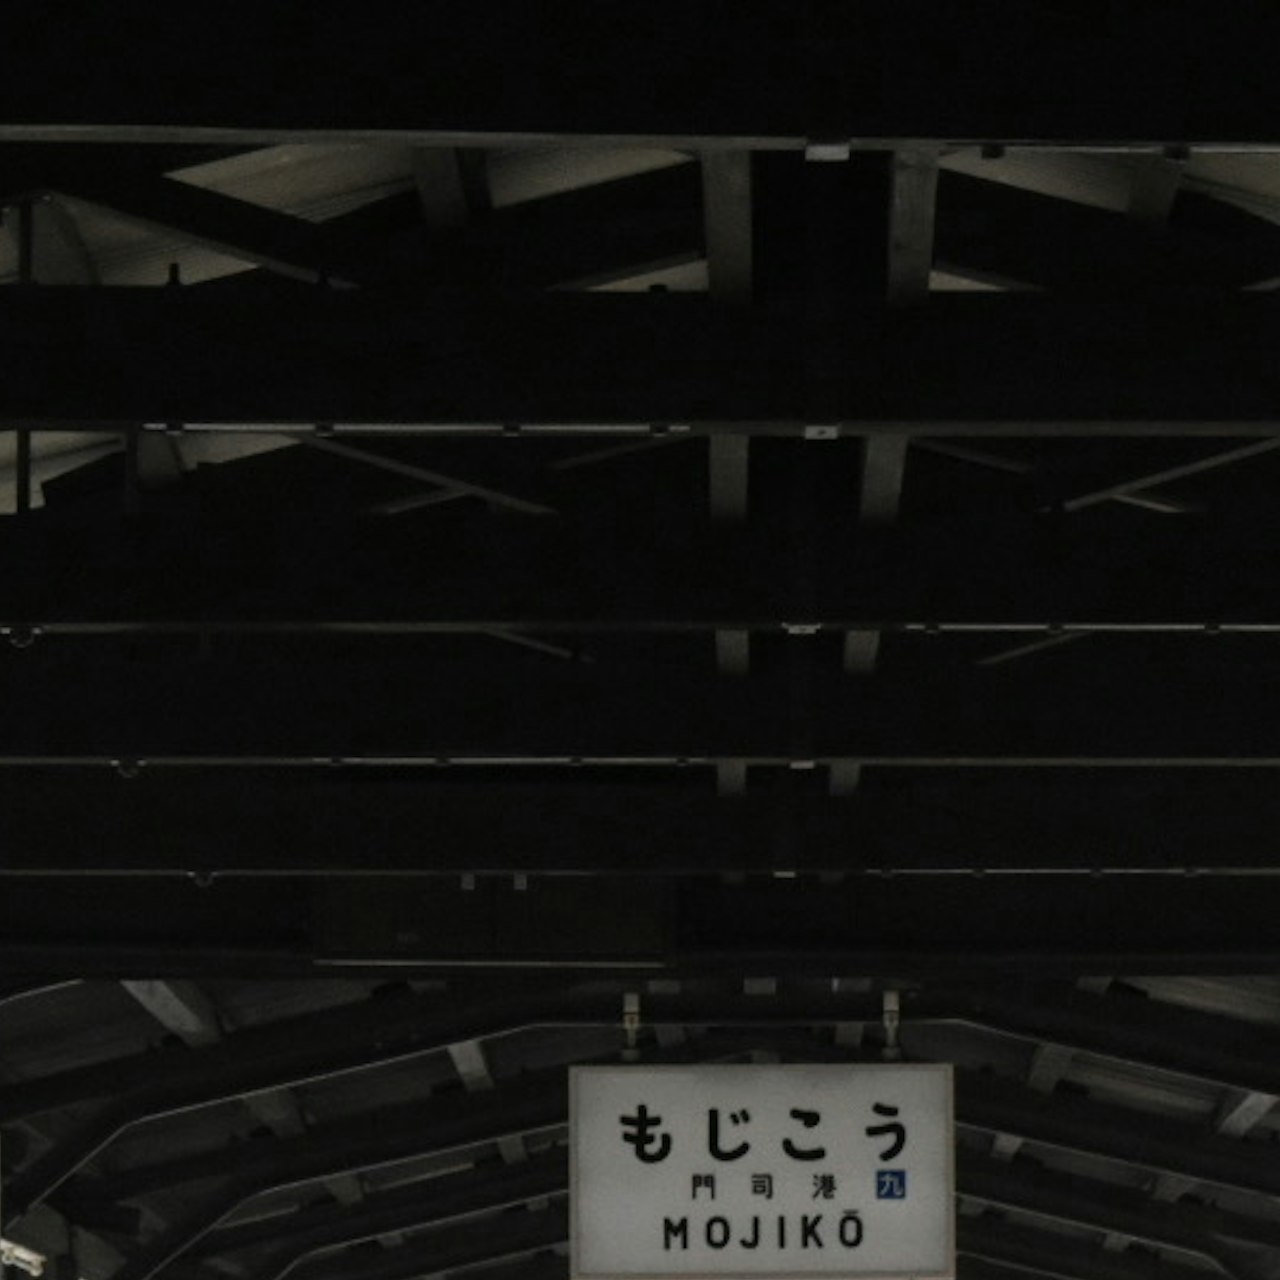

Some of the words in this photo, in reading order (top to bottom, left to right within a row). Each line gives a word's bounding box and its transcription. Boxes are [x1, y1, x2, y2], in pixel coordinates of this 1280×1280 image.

[619, 1102, 907, 1163] もじこう
[692, 1173, 837, 1200] 門司港
[878, 1173, 904, 1198] 九
